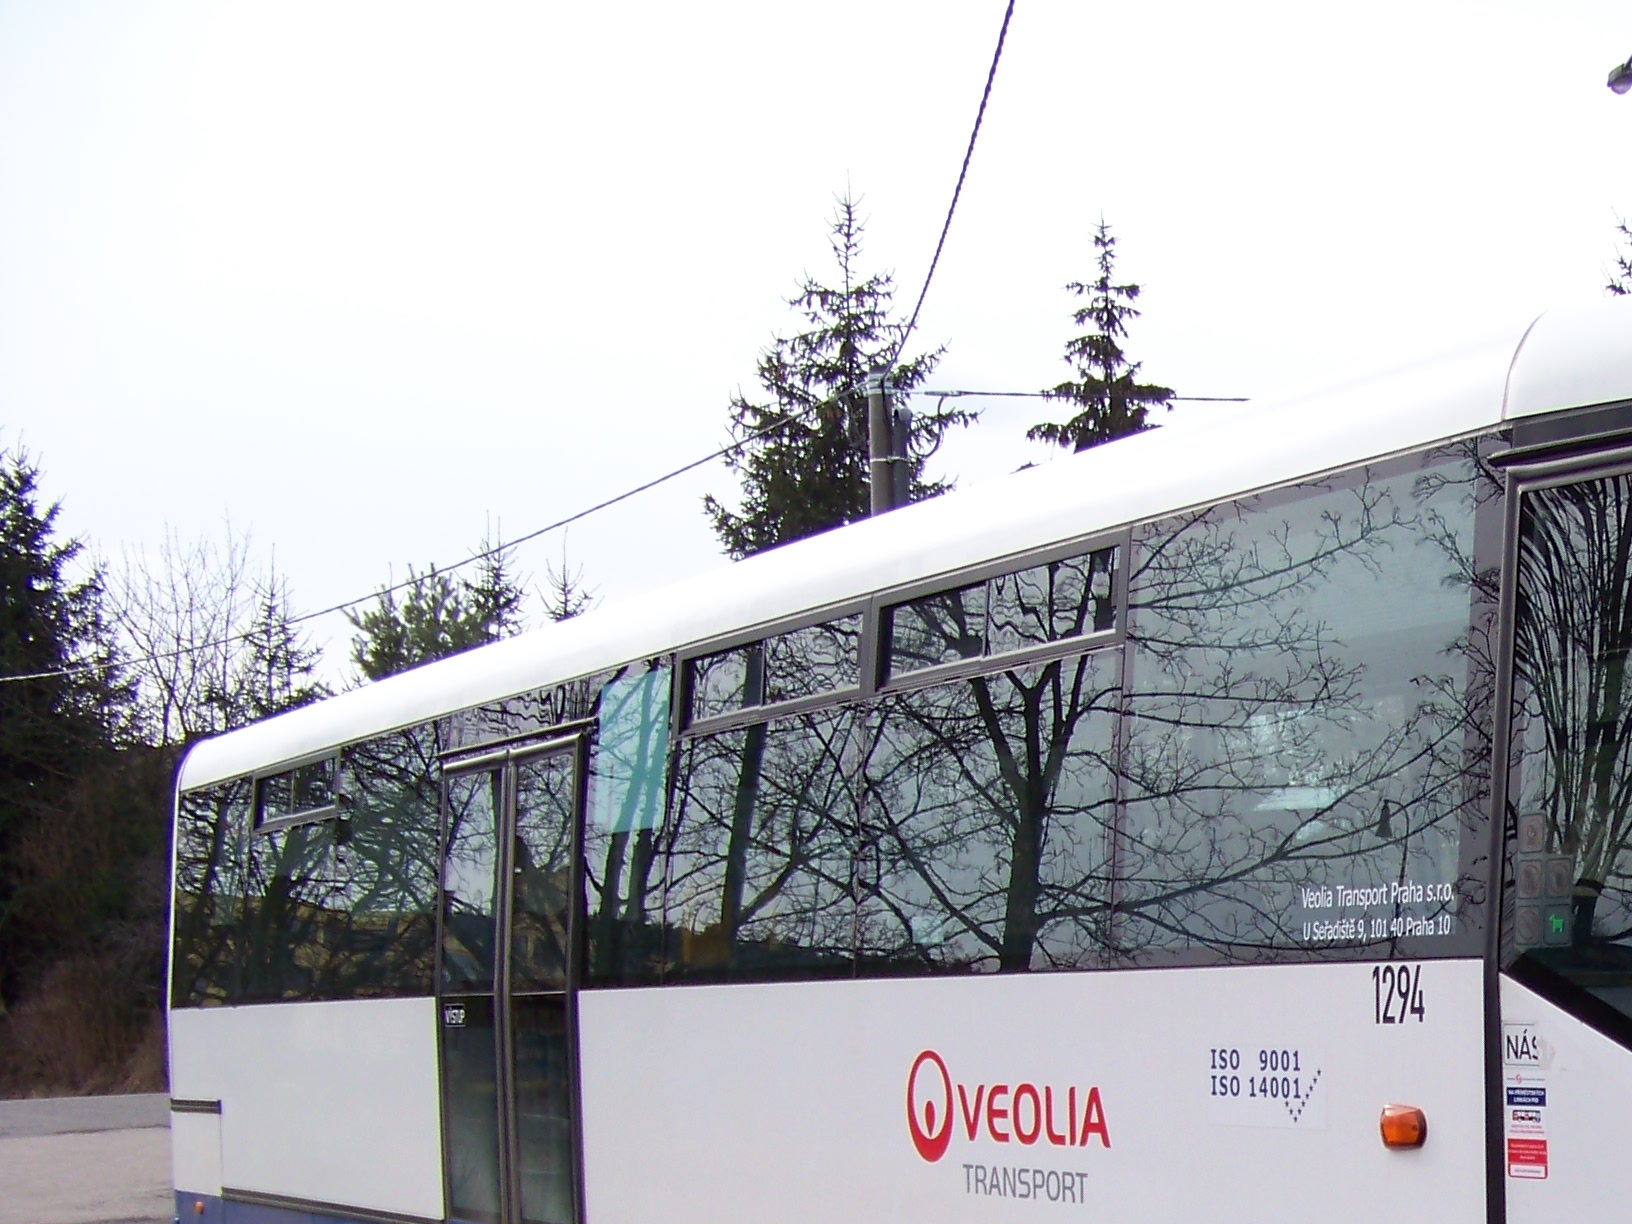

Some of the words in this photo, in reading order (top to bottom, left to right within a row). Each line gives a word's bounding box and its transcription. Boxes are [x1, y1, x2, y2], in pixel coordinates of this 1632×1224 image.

[1301, 885, 1333, 909] Veolia
[1336, 884, 1388, 911] Transport
[1391, 880, 1424, 904] Praha
[1427, 883, 1455, 902] s.r.o.
[1303, 923, 1311, 941] U
[1358, 919, 1367, 942] 9,
[1370, 919, 1388, 938] 101
[1390, 918, 1403, 938] 40
[1406, 915, 1435, 937] Praha
[1437, 915, 1451, 935] 10
[1372, 965, 1425, 1024] 1294
[1210, 1048, 1240, 1070] ISO
[1259, 1049, 1301, 1072] 9001
[1210, 1075, 1240, 1097] ISO
[1248, 1077, 1301, 1099] 14001
[957, 1083, 1111, 1148] VEOLIA
[962, 1163, 1089, 1204] TRANSPORT
